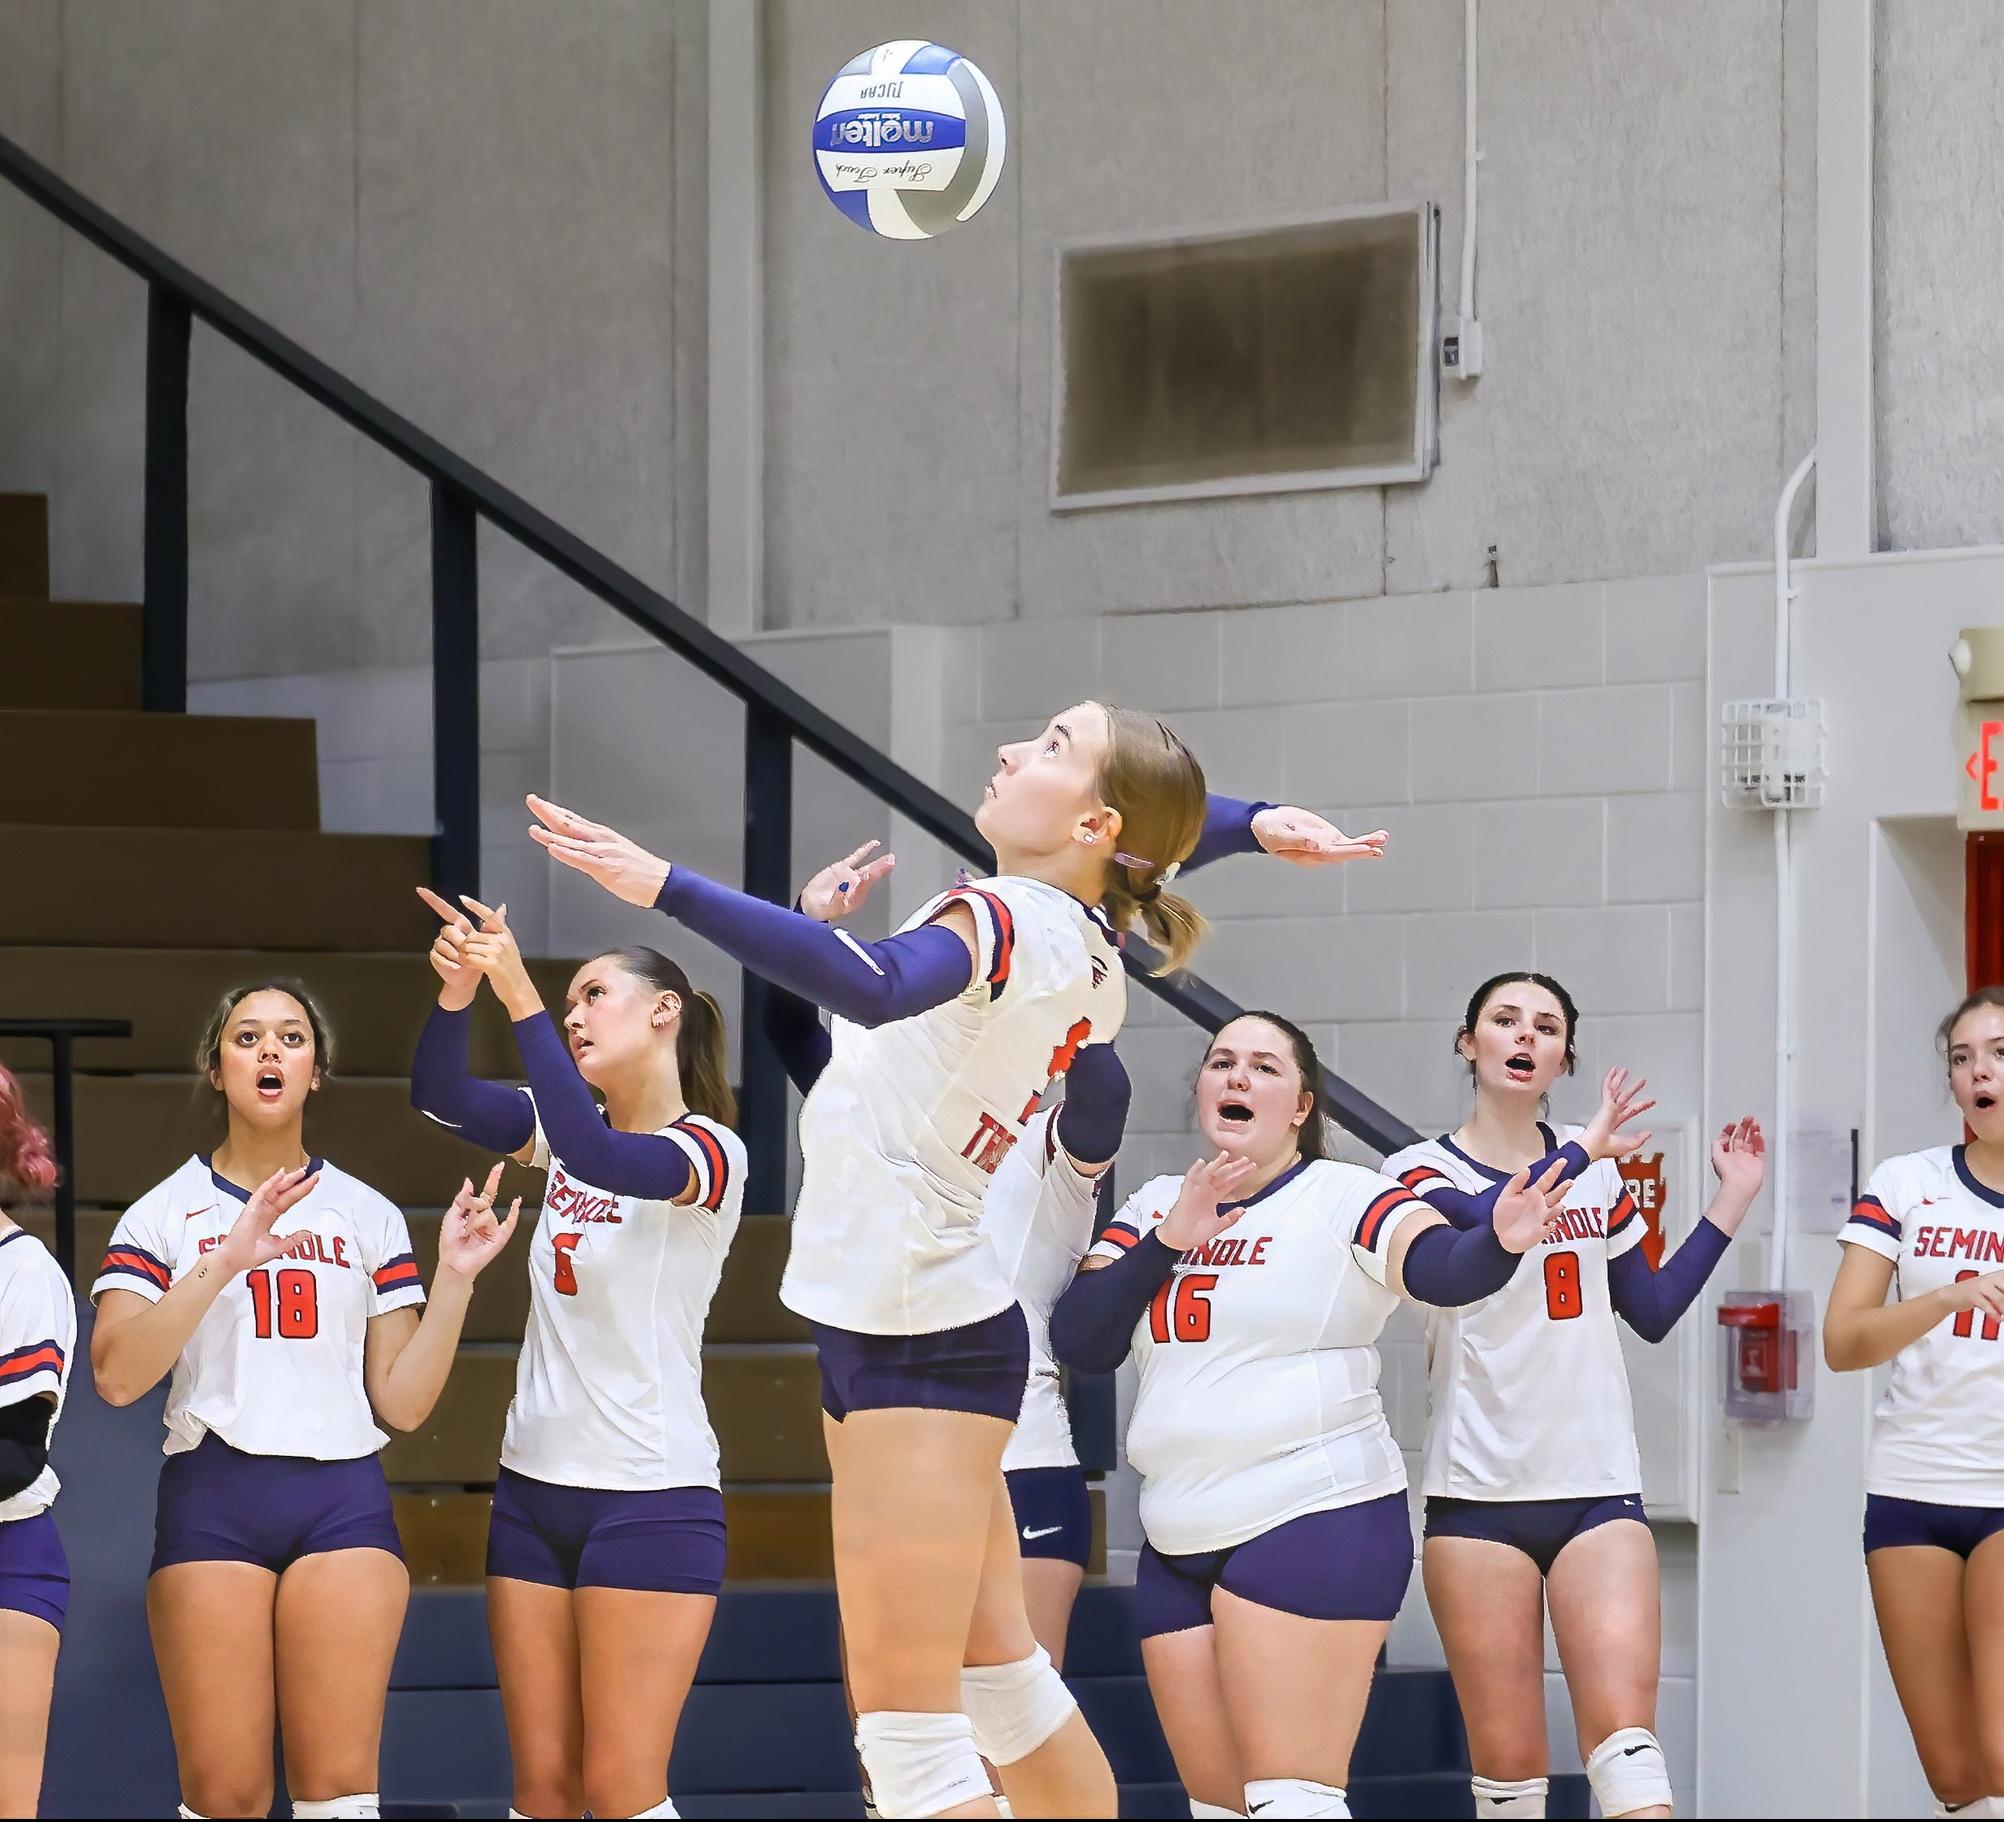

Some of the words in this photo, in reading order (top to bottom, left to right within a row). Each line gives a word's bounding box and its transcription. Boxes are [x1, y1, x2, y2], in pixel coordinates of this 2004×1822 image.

[831, 120, 934, 147] molten
[835, 164, 878, 184] Touch
[883, 160, 932, 182] Super
[1981, 720, 2004, 811] E
[246, 1269, 318, 1339] 18
[1149, 1273, 1219, 1344] 16
[1543, 1250, 1583, 1321] 8
